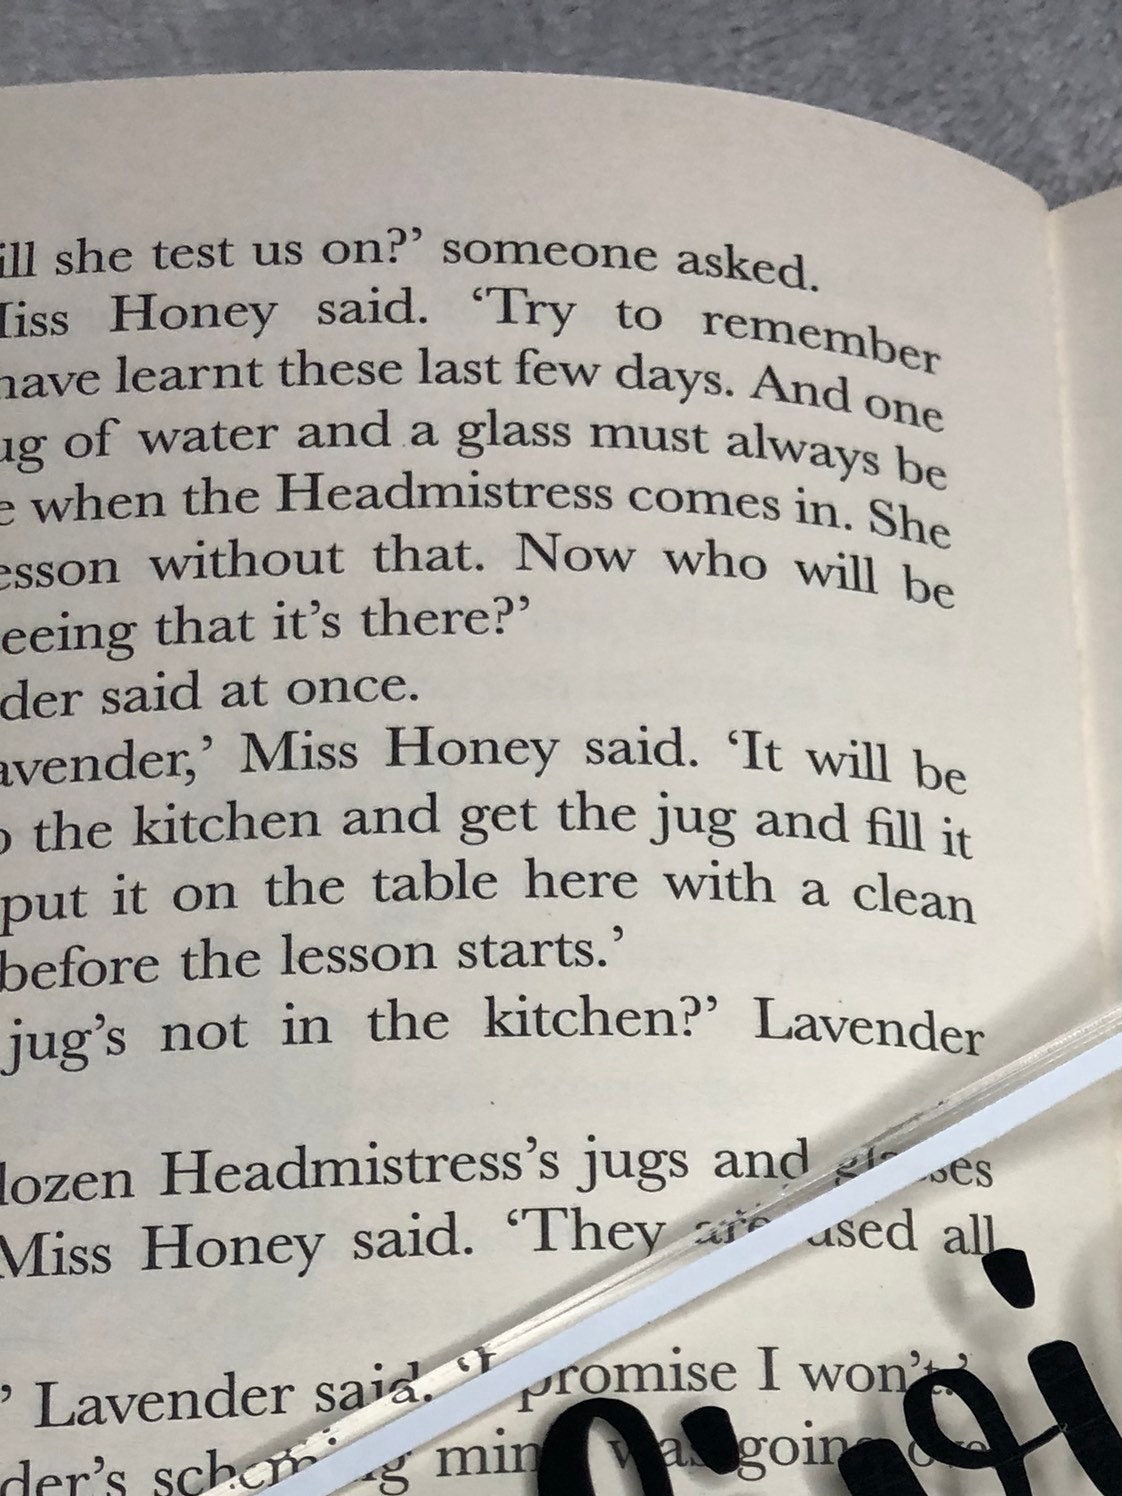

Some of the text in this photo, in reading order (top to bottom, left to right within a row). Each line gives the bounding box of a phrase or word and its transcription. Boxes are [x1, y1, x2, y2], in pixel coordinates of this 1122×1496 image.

[55, 236, 133, 276] she
[152, 237, 235, 271] test
[251, 240, 303, 267] us
[442, 239, 658, 272] someone
[677, 243, 819, 293] asked.
[109, 292, 279, 340] Honey
[317, 286, 428, 325] said.
[702, 311, 942, 375] remember
[115, 346, 945, 433] learnt these last few days. And one
[137, 407, 880, 483] water and glass must always
[30, 469, 952, 550] when Headmistress comes in. She
[148, 532, 879, 595] without that. Now who will
[154, 604, 255, 646] that
[101, 668, 419, 715] said once.
[240, 729, 358, 773] Miss
[385, 725, 561, 778] Honey
[585, 724, 699, 768] said.
[805, 739, 892, 783] will
[132, 789, 926, 852] kitchen get the jug and fill
[264, 856, 977, 925] the table here with clean
[180, 936, 261, 982] the
[280, 932, 438, 976] lesson
[160, 1013, 249, 1052] not
[367, 997, 450, 1042] the
[753, 996, 986, 1057] Lavender
[575, 1134, 689, 1194] jugs
[714, 1136, 809, 1190] and
[141, 1223, 326, 1278] Honey
[353, 1210, 474, 1260] said.
[33, 1370, 296, 1429] Lavender
